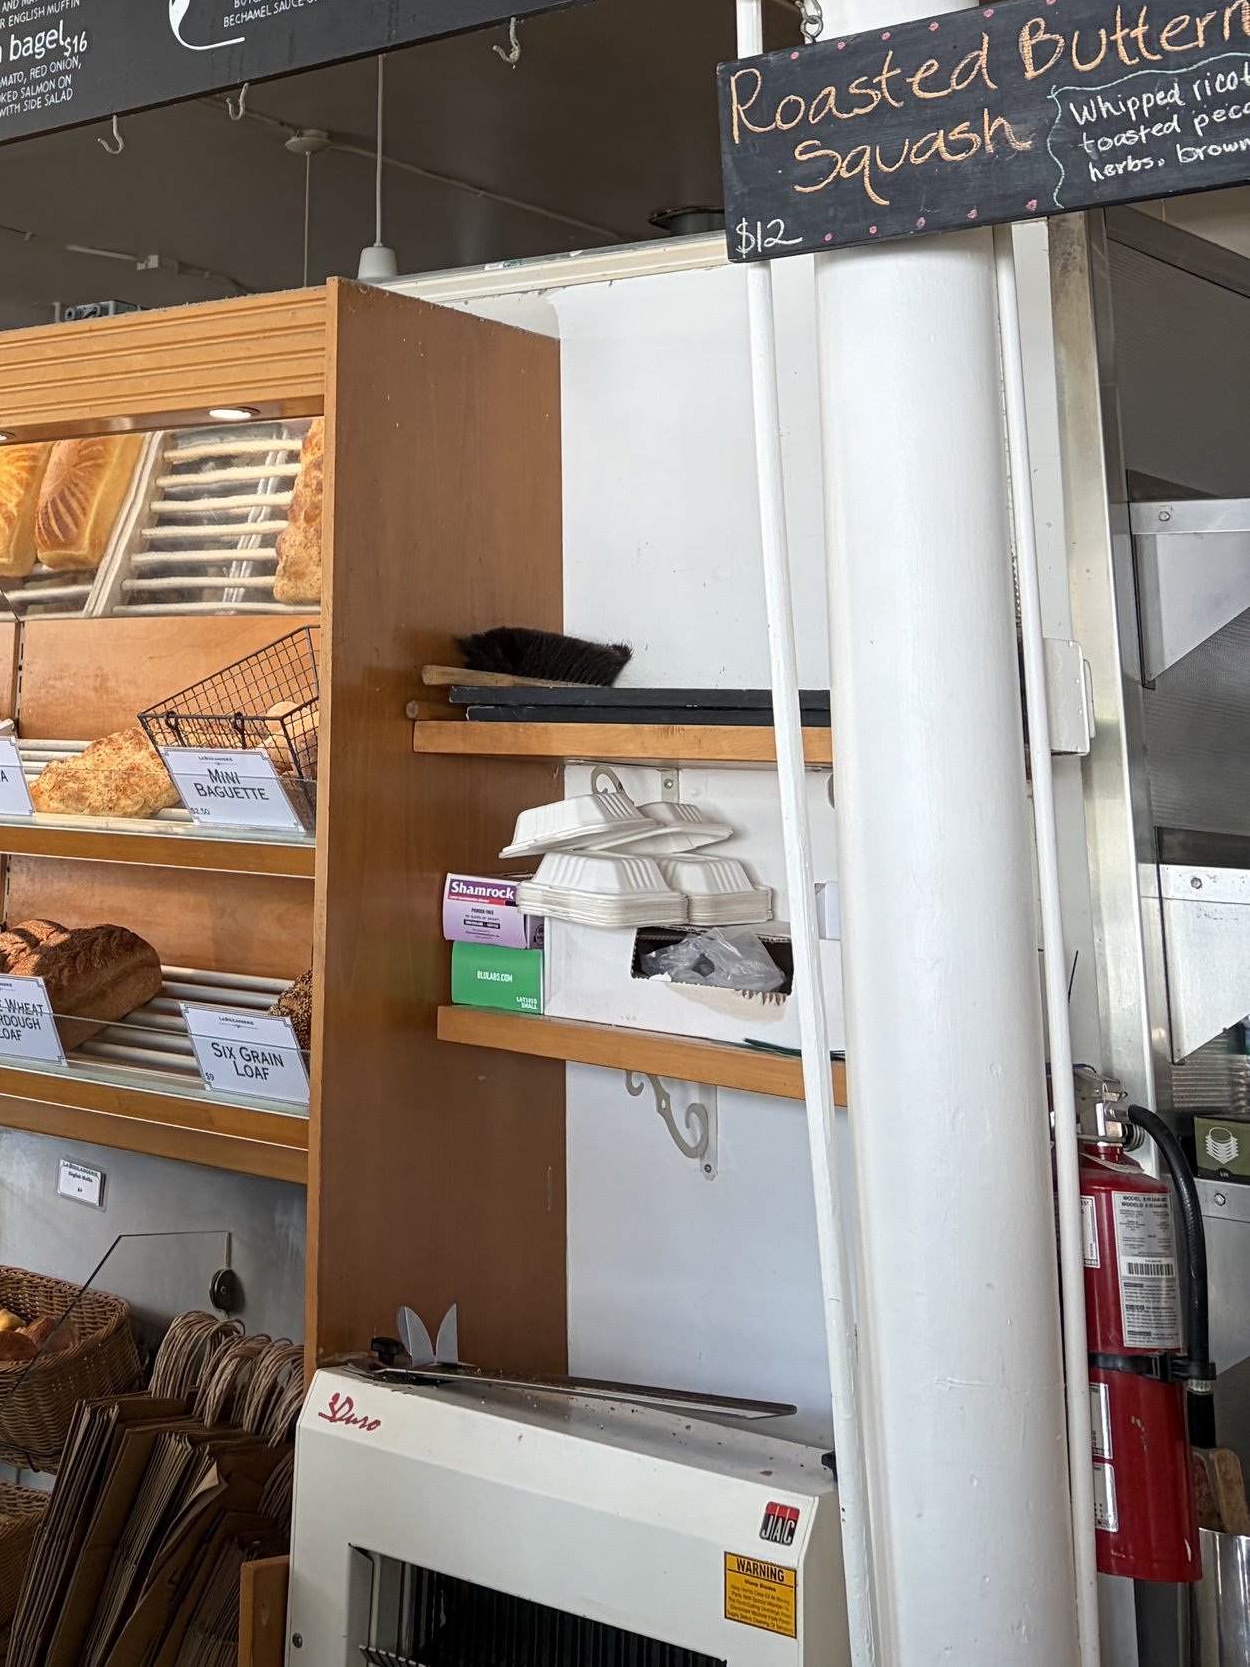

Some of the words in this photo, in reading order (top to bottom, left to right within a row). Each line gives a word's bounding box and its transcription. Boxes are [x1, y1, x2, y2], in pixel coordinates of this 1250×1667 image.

[10, 20, 65, 62] bagel
[729, 33, 997, 144] Roasted
[1078, 114, 1181, 154] toasted
[793, 107, 1033, 206] Squash
[735, 216, 803, 258] $12
[207, 768, 241, 784] MINI
[194, 783, 270, 800] BAGUETTE
[451, 882, 514, 899] Shamrock
[5, 998, 43, 1016] WHEAT
[211, 1042, 236, 1060] SIX
[239, 1047, 284, 1067] GRAIN
[233, 1060, 270, 1080] LOAF
[761, 1514, 795, 1544] JAC
[736, 1558, 784, 1582] WARNING
